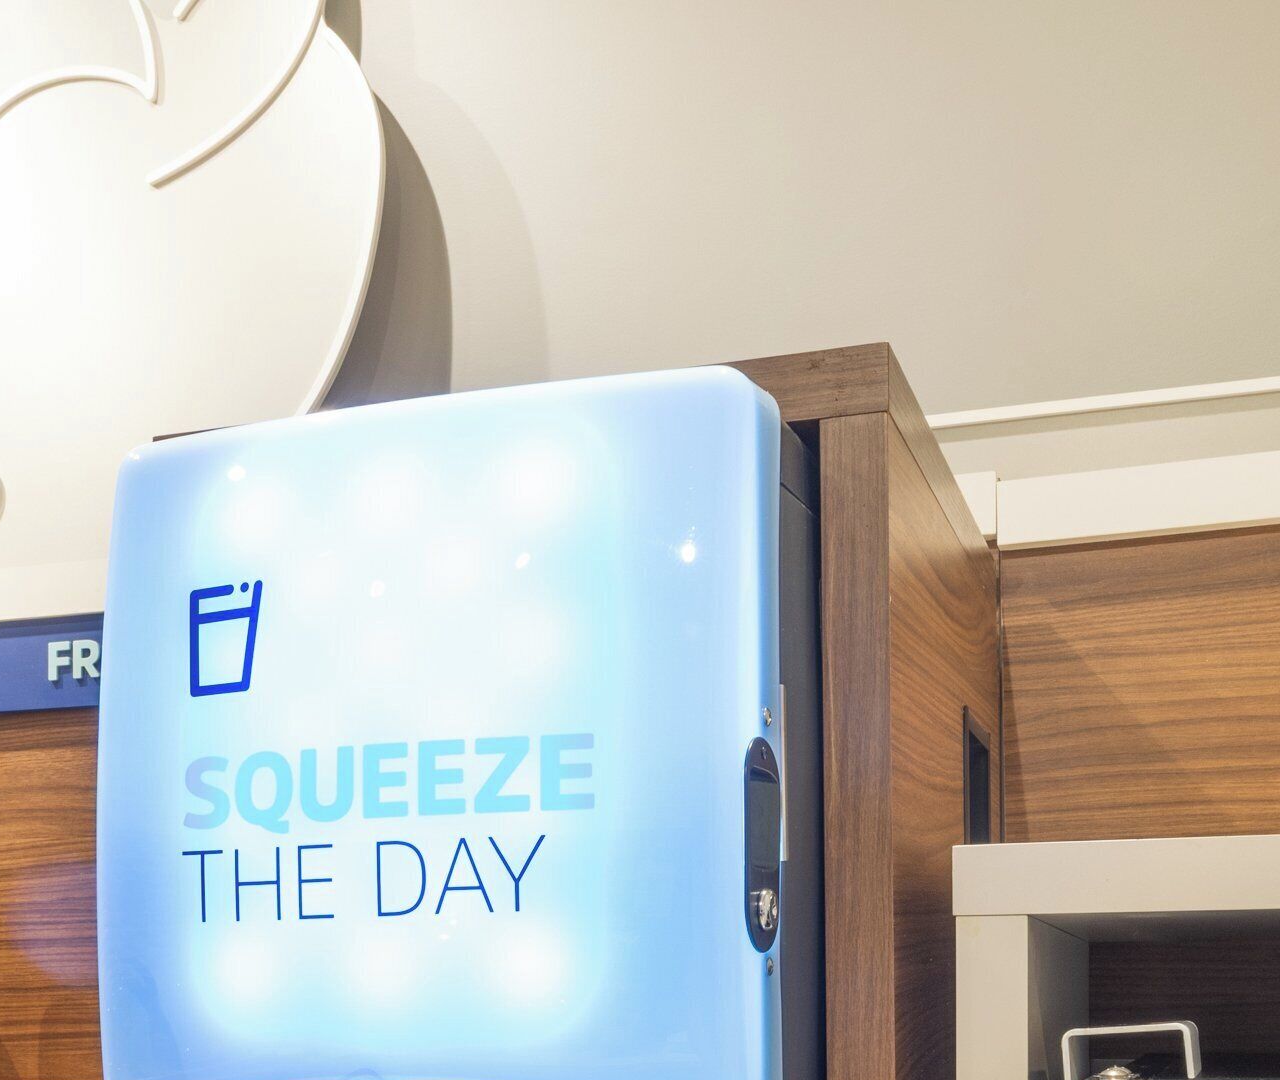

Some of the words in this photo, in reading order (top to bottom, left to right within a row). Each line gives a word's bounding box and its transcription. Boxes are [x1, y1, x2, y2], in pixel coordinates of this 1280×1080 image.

[182, 732, 596, 834] SQUEEZE
[182, 843, 335, 923] THE
[375, 834, 546, 917] DAY
